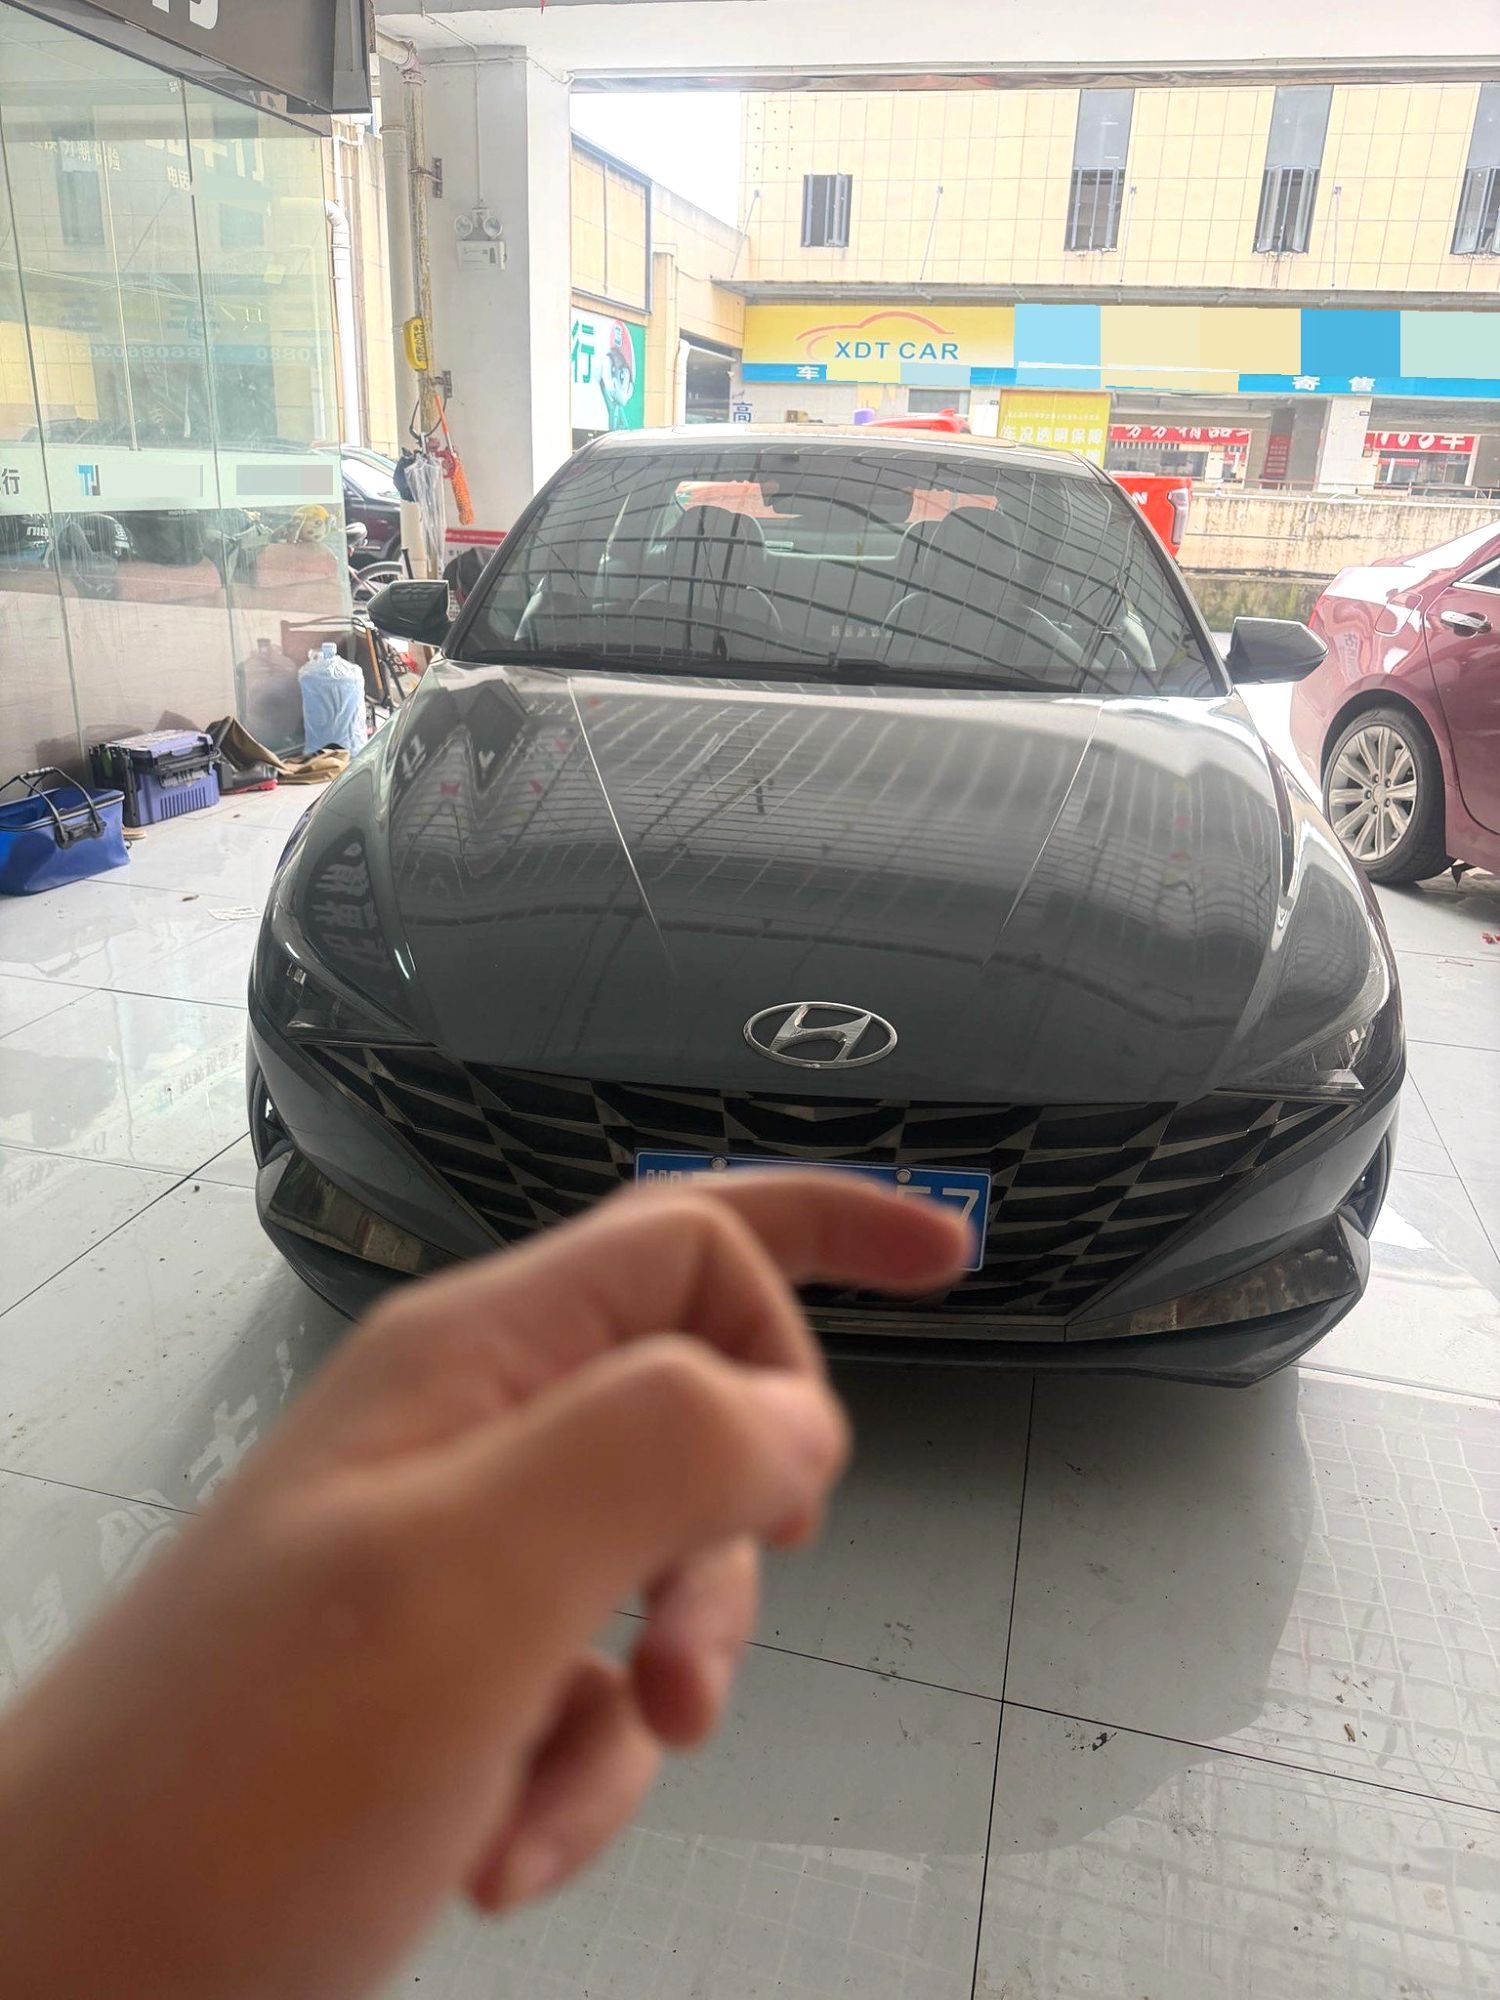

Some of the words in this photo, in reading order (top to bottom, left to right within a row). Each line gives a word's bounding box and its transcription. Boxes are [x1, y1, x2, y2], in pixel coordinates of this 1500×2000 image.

[571, 319, 595, 383] 行
[835, 341, 891, 360] XDT
[898, 342, 959, 361] CAR
[796, 365, 820, 380] 车
